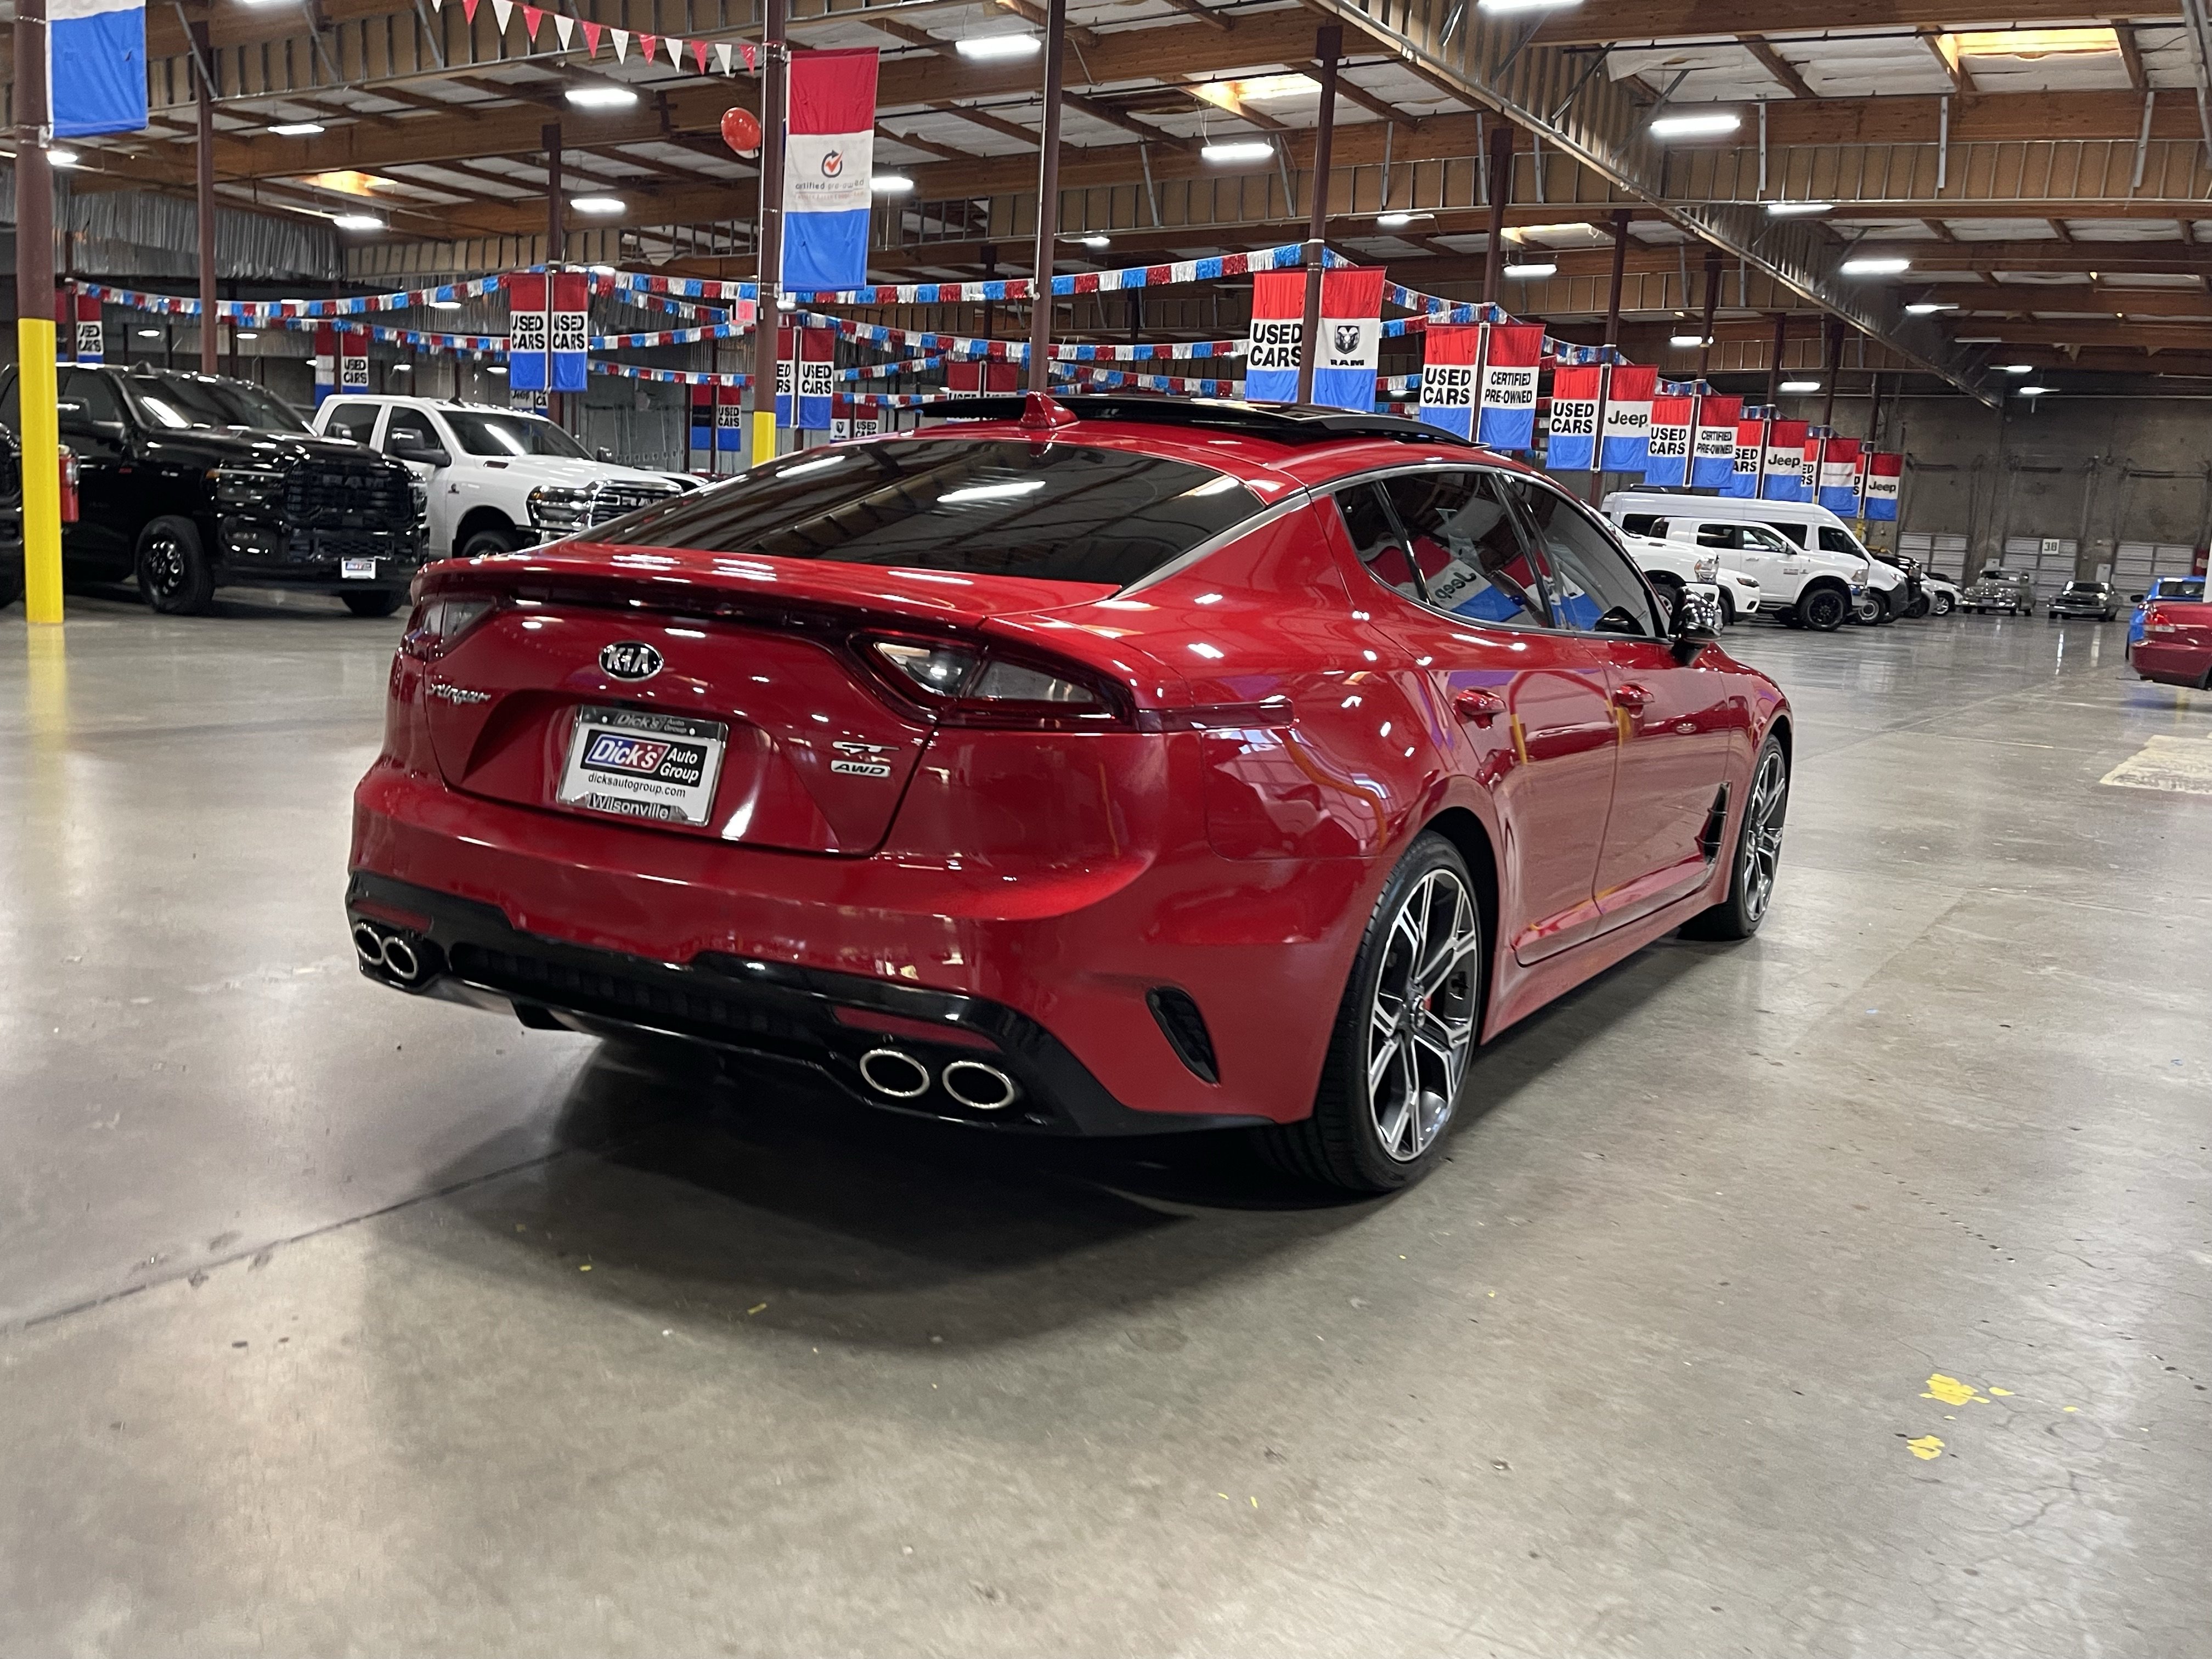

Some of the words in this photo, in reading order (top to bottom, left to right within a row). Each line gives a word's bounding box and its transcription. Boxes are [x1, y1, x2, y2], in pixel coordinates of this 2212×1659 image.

[828, 179, 865, 190] pre-owed
[511, 314, 544, 331] USED
[554, 314, 584, 331] USED
[511, 333, 545, 349] CARS
[552, 333, 585, 349] CARS
[1252, 323, 1302, 345] USED
[1250, 345, 1302, 367] CARS
[777, 364, 791, 377] ED
[803, 364, 832, 379] USED
[1425, 368, 1471, 386] USED
[1491, 371, 1531, 386] CERTIFIED
[802, 380, 832, 394] CARS
[1423, 386, 1470, 405] CARS
[1484, 388, 1532, 404] PRE-OWNED
[718, 407, 740, 416] USED
[1553, 402, 1594, 417] USED
[856, 421, 877, 430] USED
[1551, 418, 1593, 433] CARS
[1607, 410, 1648, 428] Jeep
[1651, 427, 1687, 441] USED
[1701, 430, 1732, 442] CERTIFIED
[1649, 441, 1686, 455] CARS
[1696, 443, 1733, 455] PRE-OWNED
[1735, 448, 1758, 460] SED
[1733, 461, 1757, 472] ARS
[1768, 454, 1801, 468] Jeep
[1868, 481, 1897, 493] Jeep
[606, 647, 650, 674] KIA
[591, 740, 657, 769] Dick's
[667, 747, 698, 765] Auto
[660, 763, 699, 784] Group
[834, 764, 885, 775] AWD
[588, 772, 686, 798] dicksautogroup.com
[591, 793, 669, 820] Wilsonville
